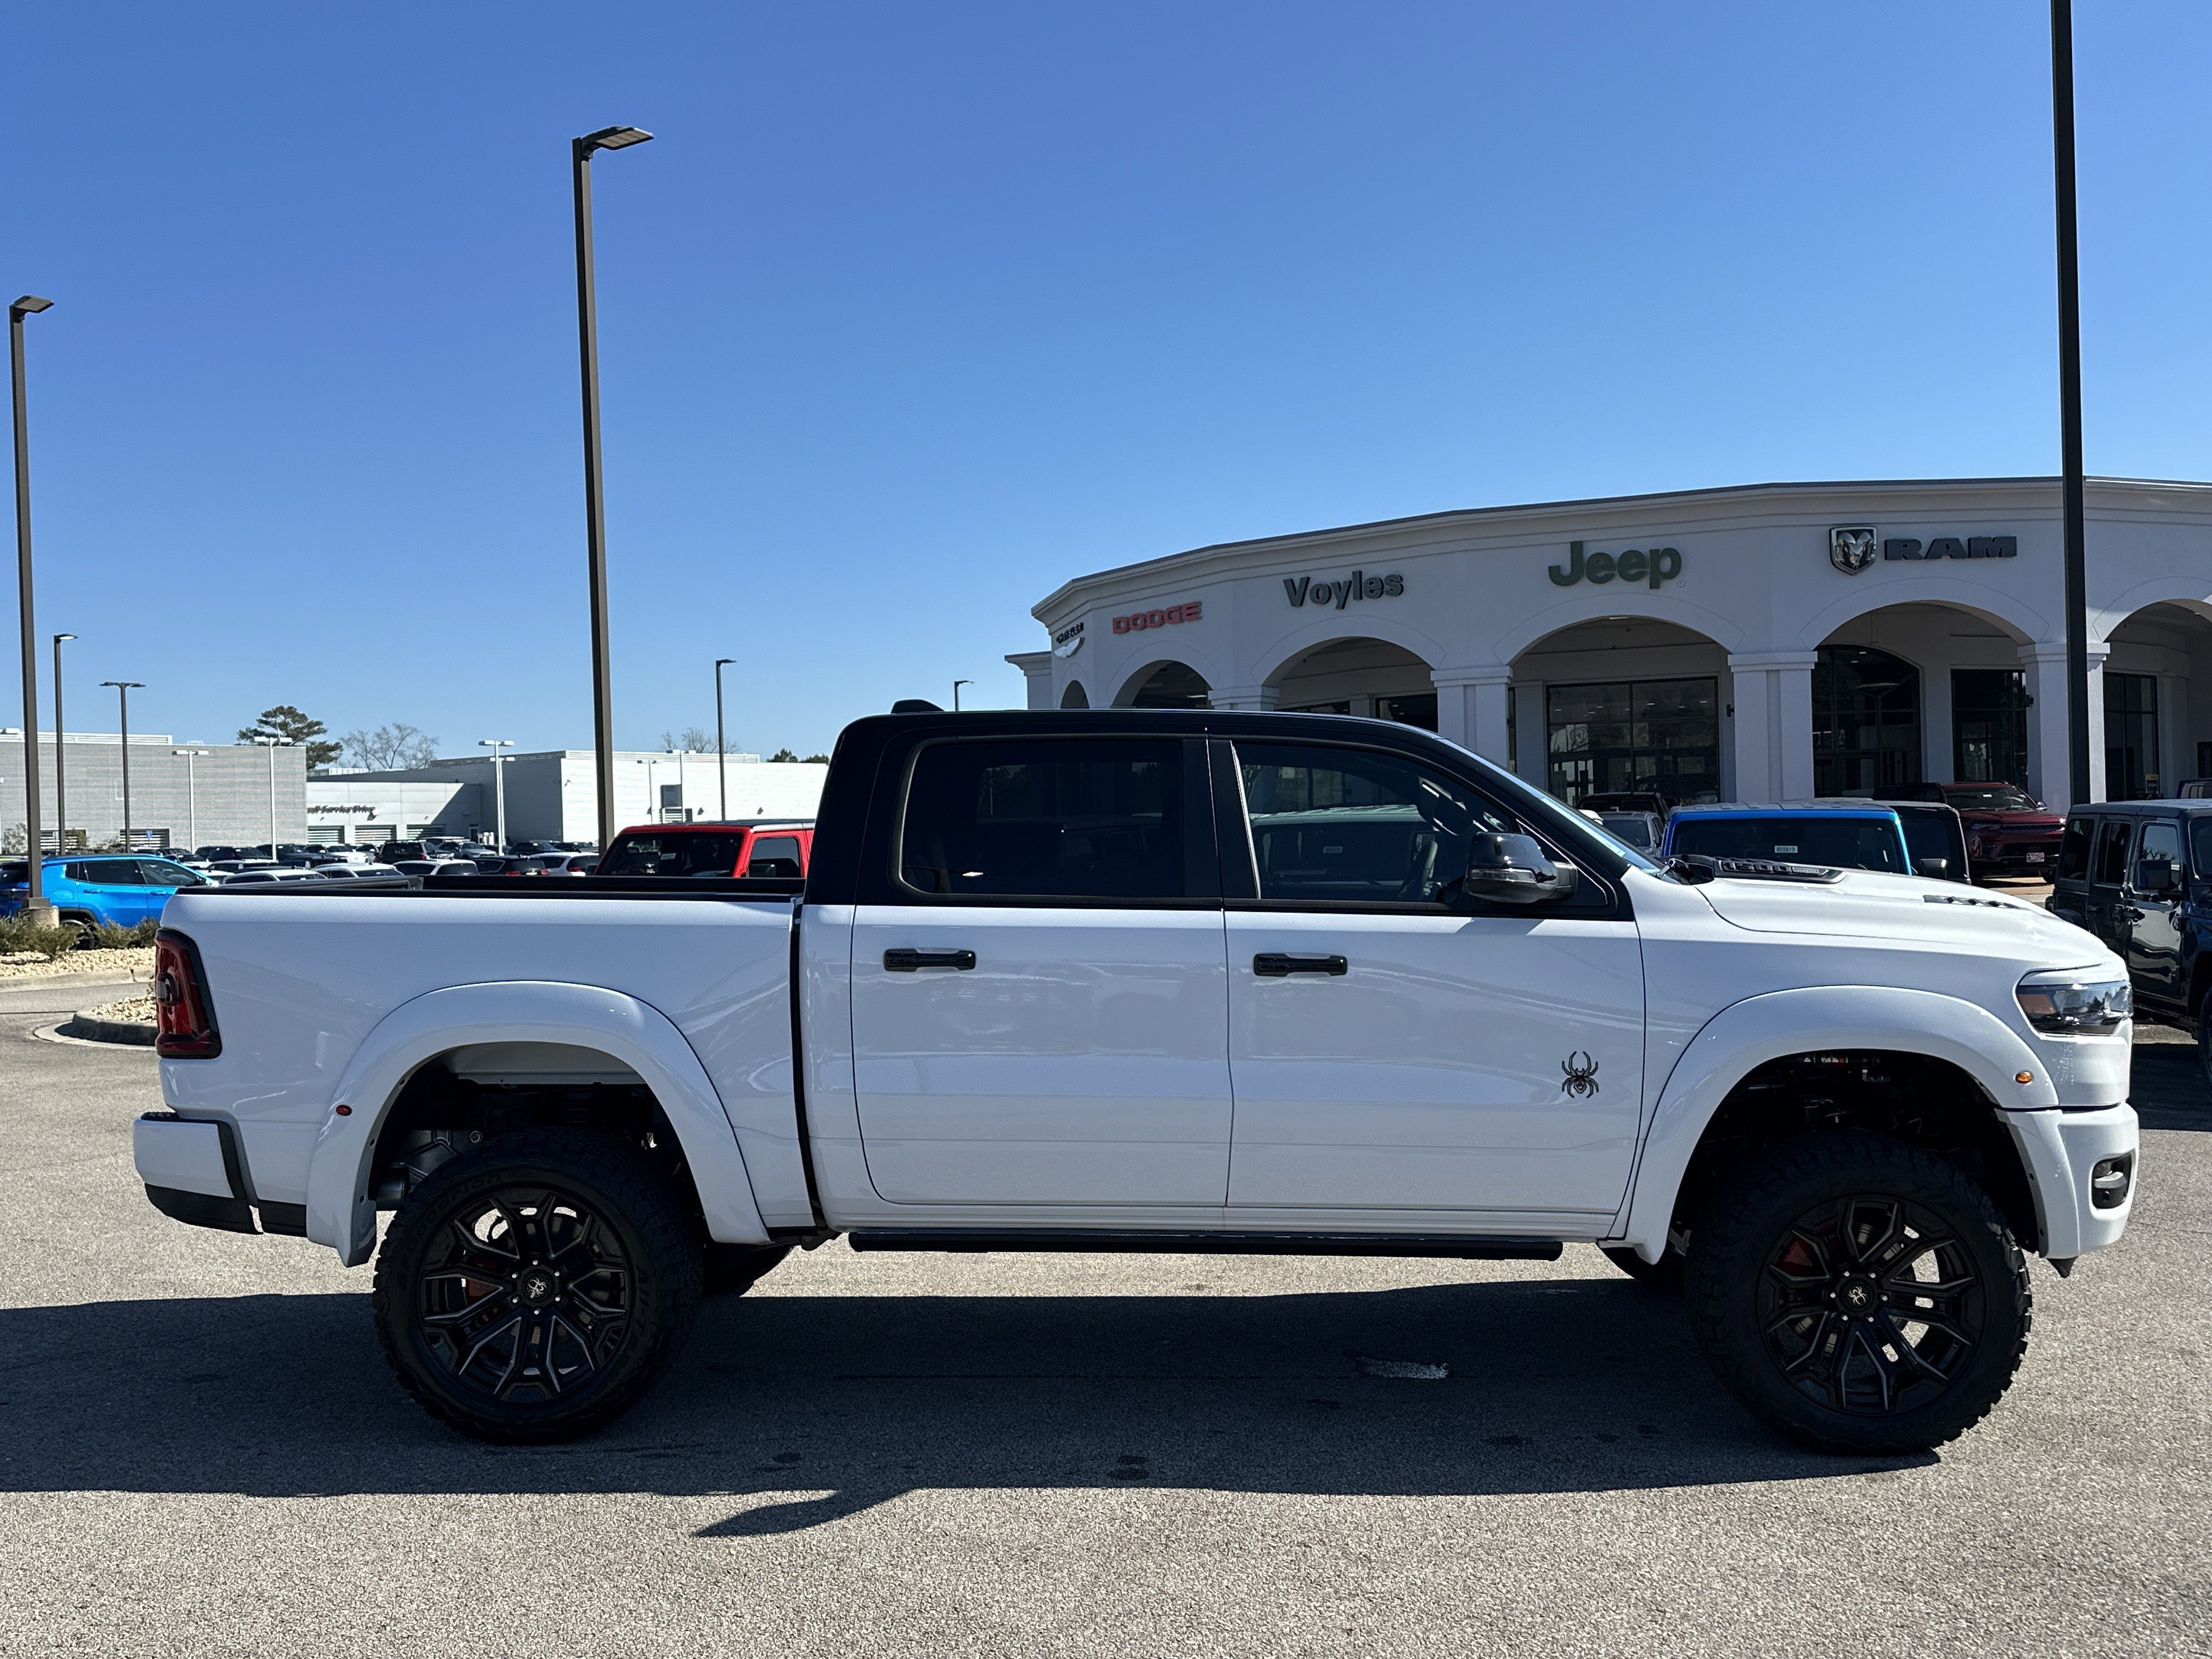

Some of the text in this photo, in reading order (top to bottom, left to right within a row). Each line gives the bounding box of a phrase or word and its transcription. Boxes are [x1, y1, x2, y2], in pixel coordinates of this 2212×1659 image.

[1548, 540, 1681, 589] Jeep
[1884, 536, 2017, 560] RAM
[1283, 570, 1404, 610] Voyles
[1113, 601, 1202, 634] DODGE
